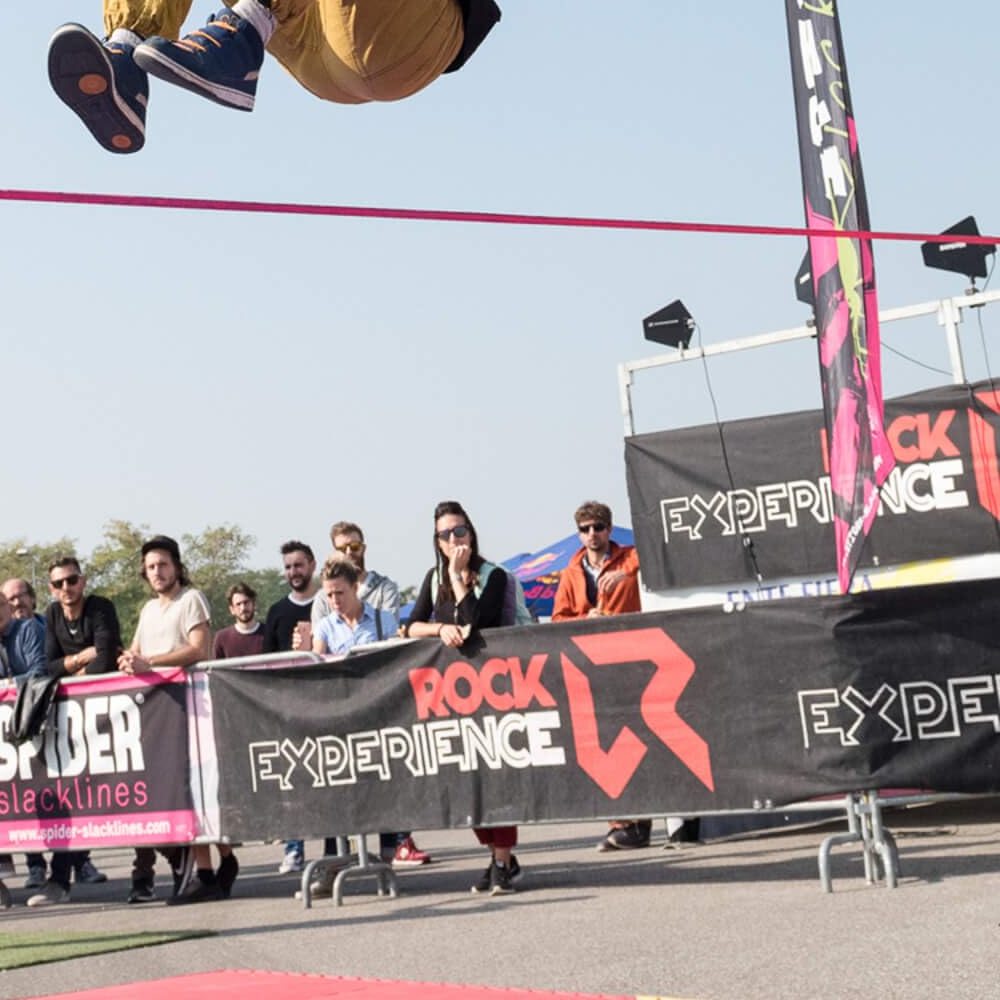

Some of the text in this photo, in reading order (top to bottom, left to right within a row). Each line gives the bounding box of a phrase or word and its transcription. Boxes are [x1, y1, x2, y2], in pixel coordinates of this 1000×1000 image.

[660, 459, 969, 544] EXPERINCE
[408, 653, 558, 721] ROCK
[797, 673, 1000, 749] EXPE
[248, 710, 566, 792] EXPERIENCE
[8, 820, 171, 845] www.spider-slacklines.com
